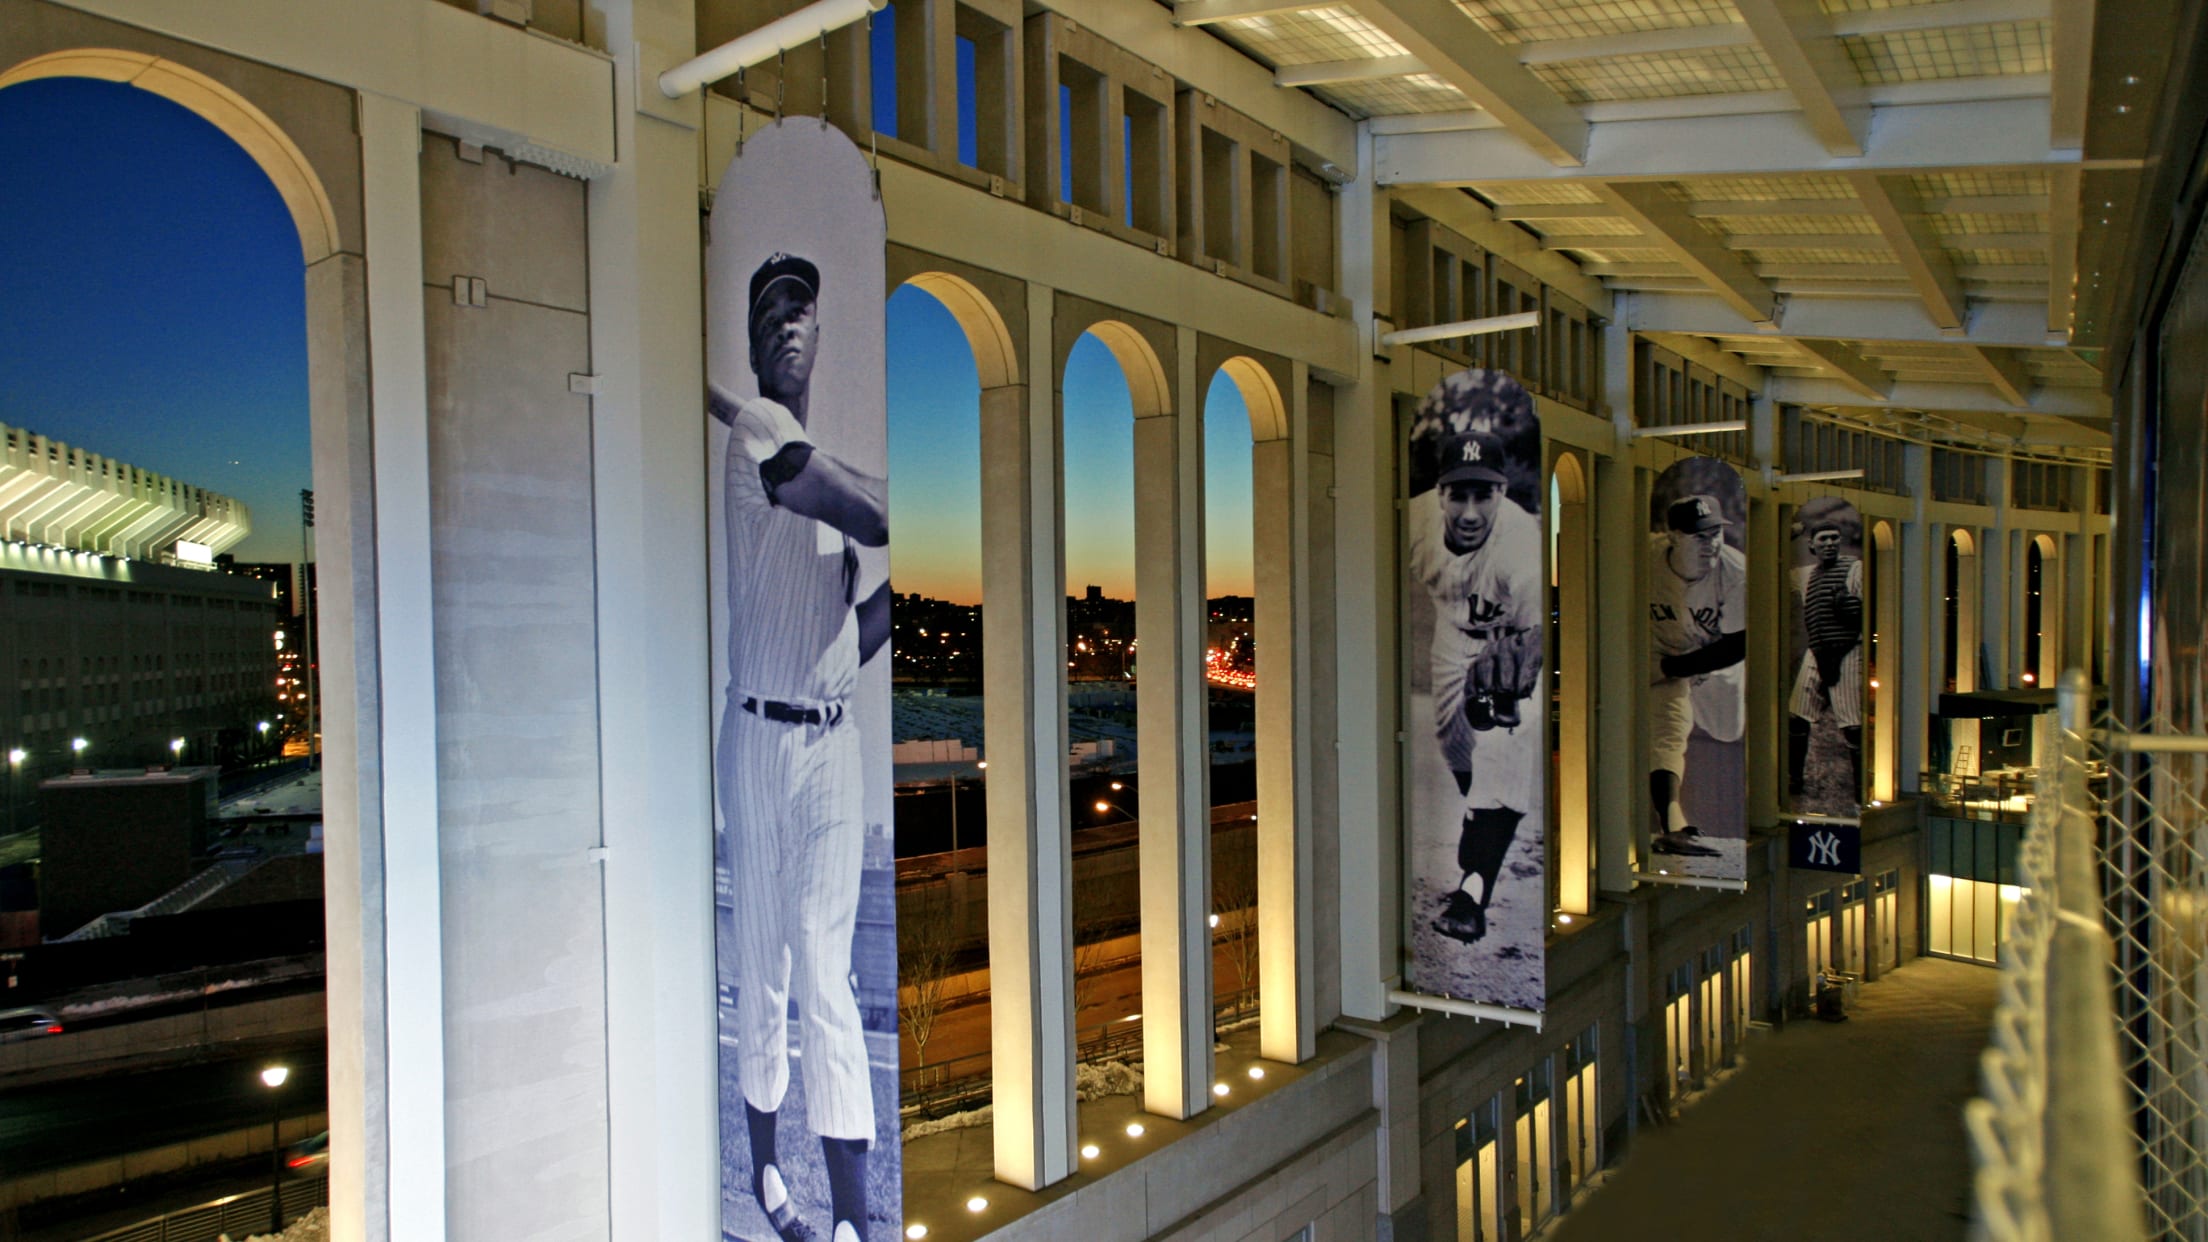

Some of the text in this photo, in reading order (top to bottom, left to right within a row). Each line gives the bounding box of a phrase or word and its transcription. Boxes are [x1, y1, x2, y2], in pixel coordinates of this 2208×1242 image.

[1462, 440, 1481, 461] NY
[1650, 603, 1677, 621] EW
[1807, 830, 1841, 866] NY
